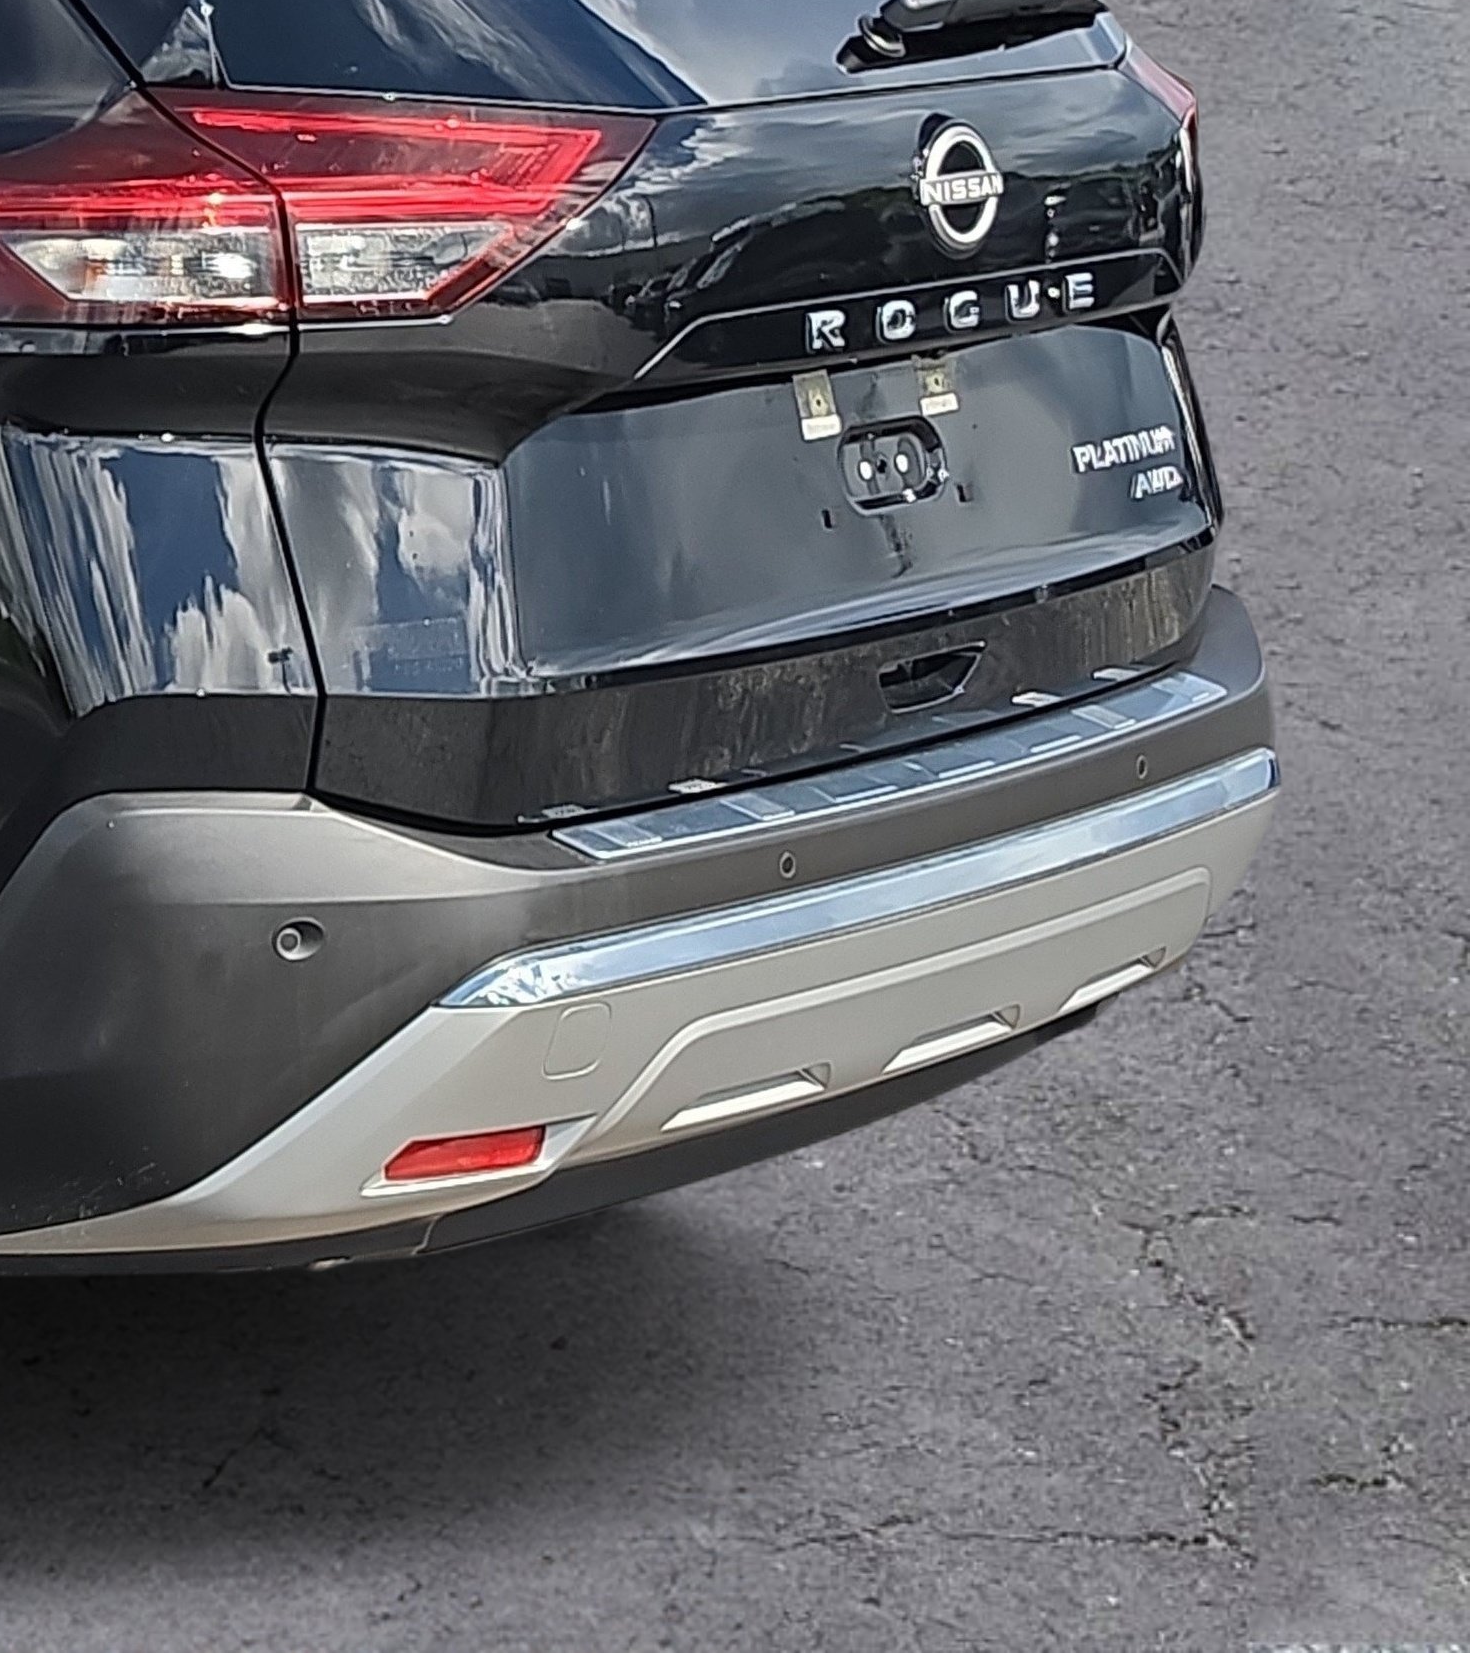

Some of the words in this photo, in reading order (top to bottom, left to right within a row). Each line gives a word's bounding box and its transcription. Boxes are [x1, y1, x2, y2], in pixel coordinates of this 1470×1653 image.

[923, 173, 1003, 204] NISSAN
[807, 273, 1094, 350] ROGUE
[1072, 426, 1176, 473] PLATINUM
[1131, 465, 1183, 499] AWD
